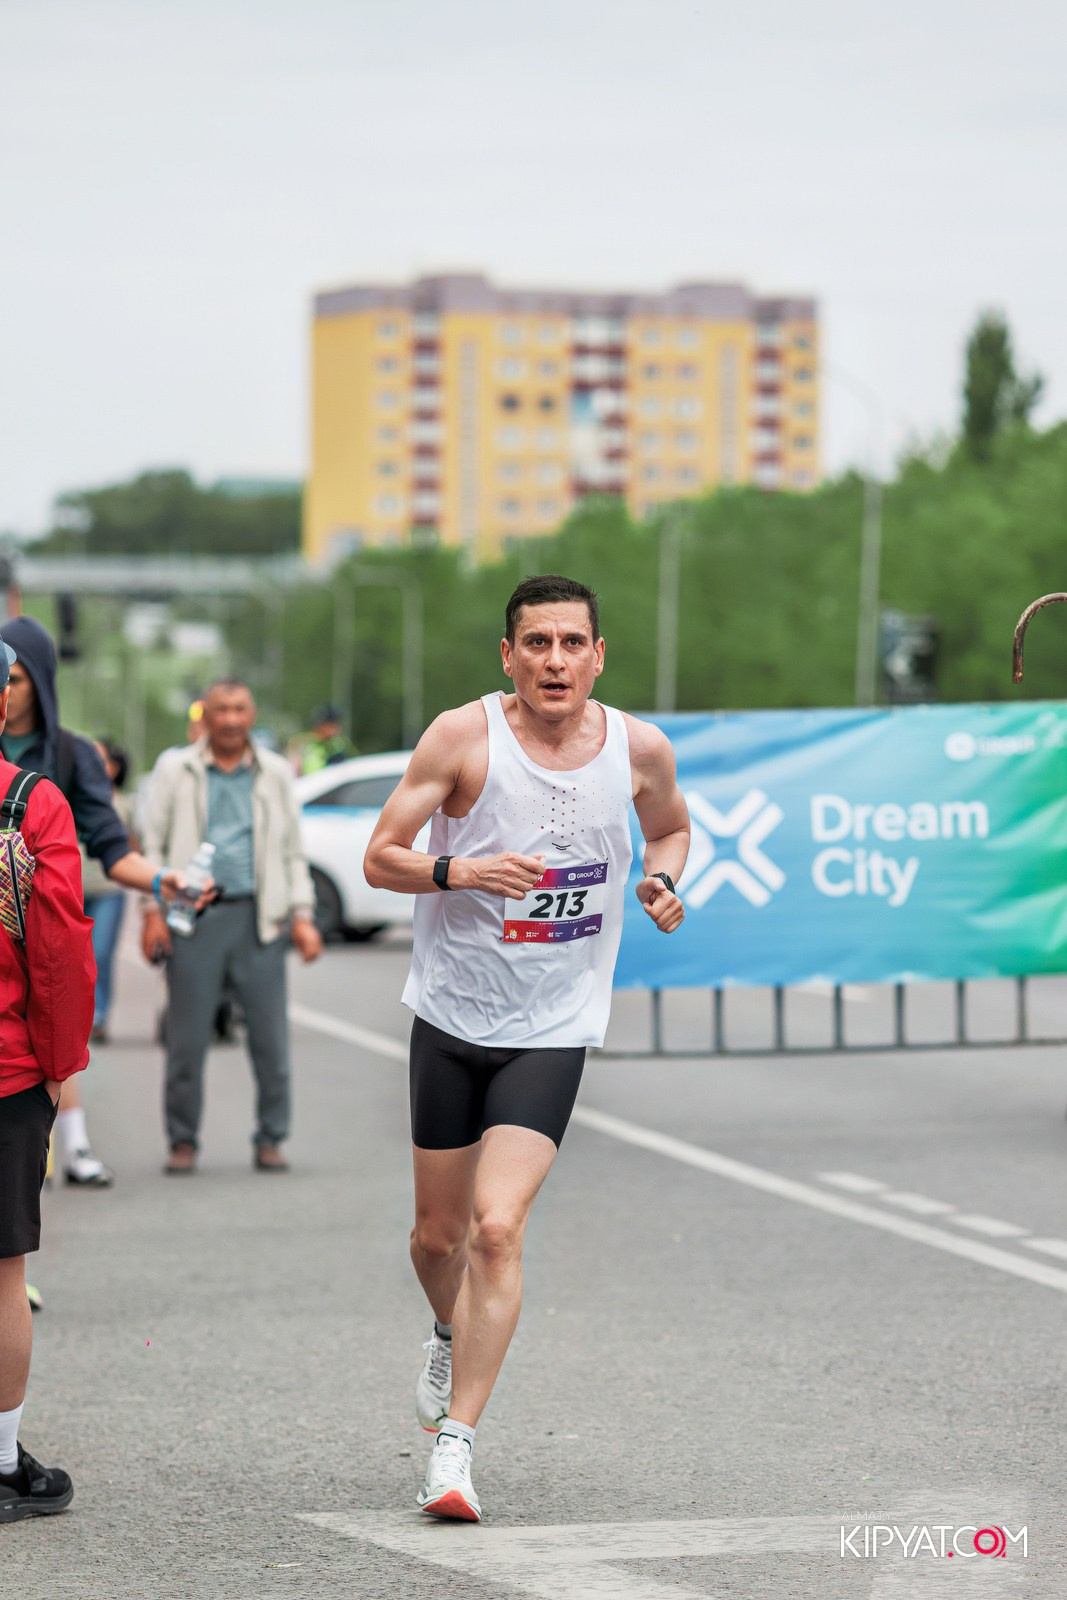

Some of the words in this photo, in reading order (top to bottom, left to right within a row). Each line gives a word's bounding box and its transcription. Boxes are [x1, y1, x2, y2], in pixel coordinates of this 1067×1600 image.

[811, 794, 989, 842] Dream
[576, 871, 594, 879] GROUP
[811, 847, 919, 907] City
[528, 890, 588, 918] 213
